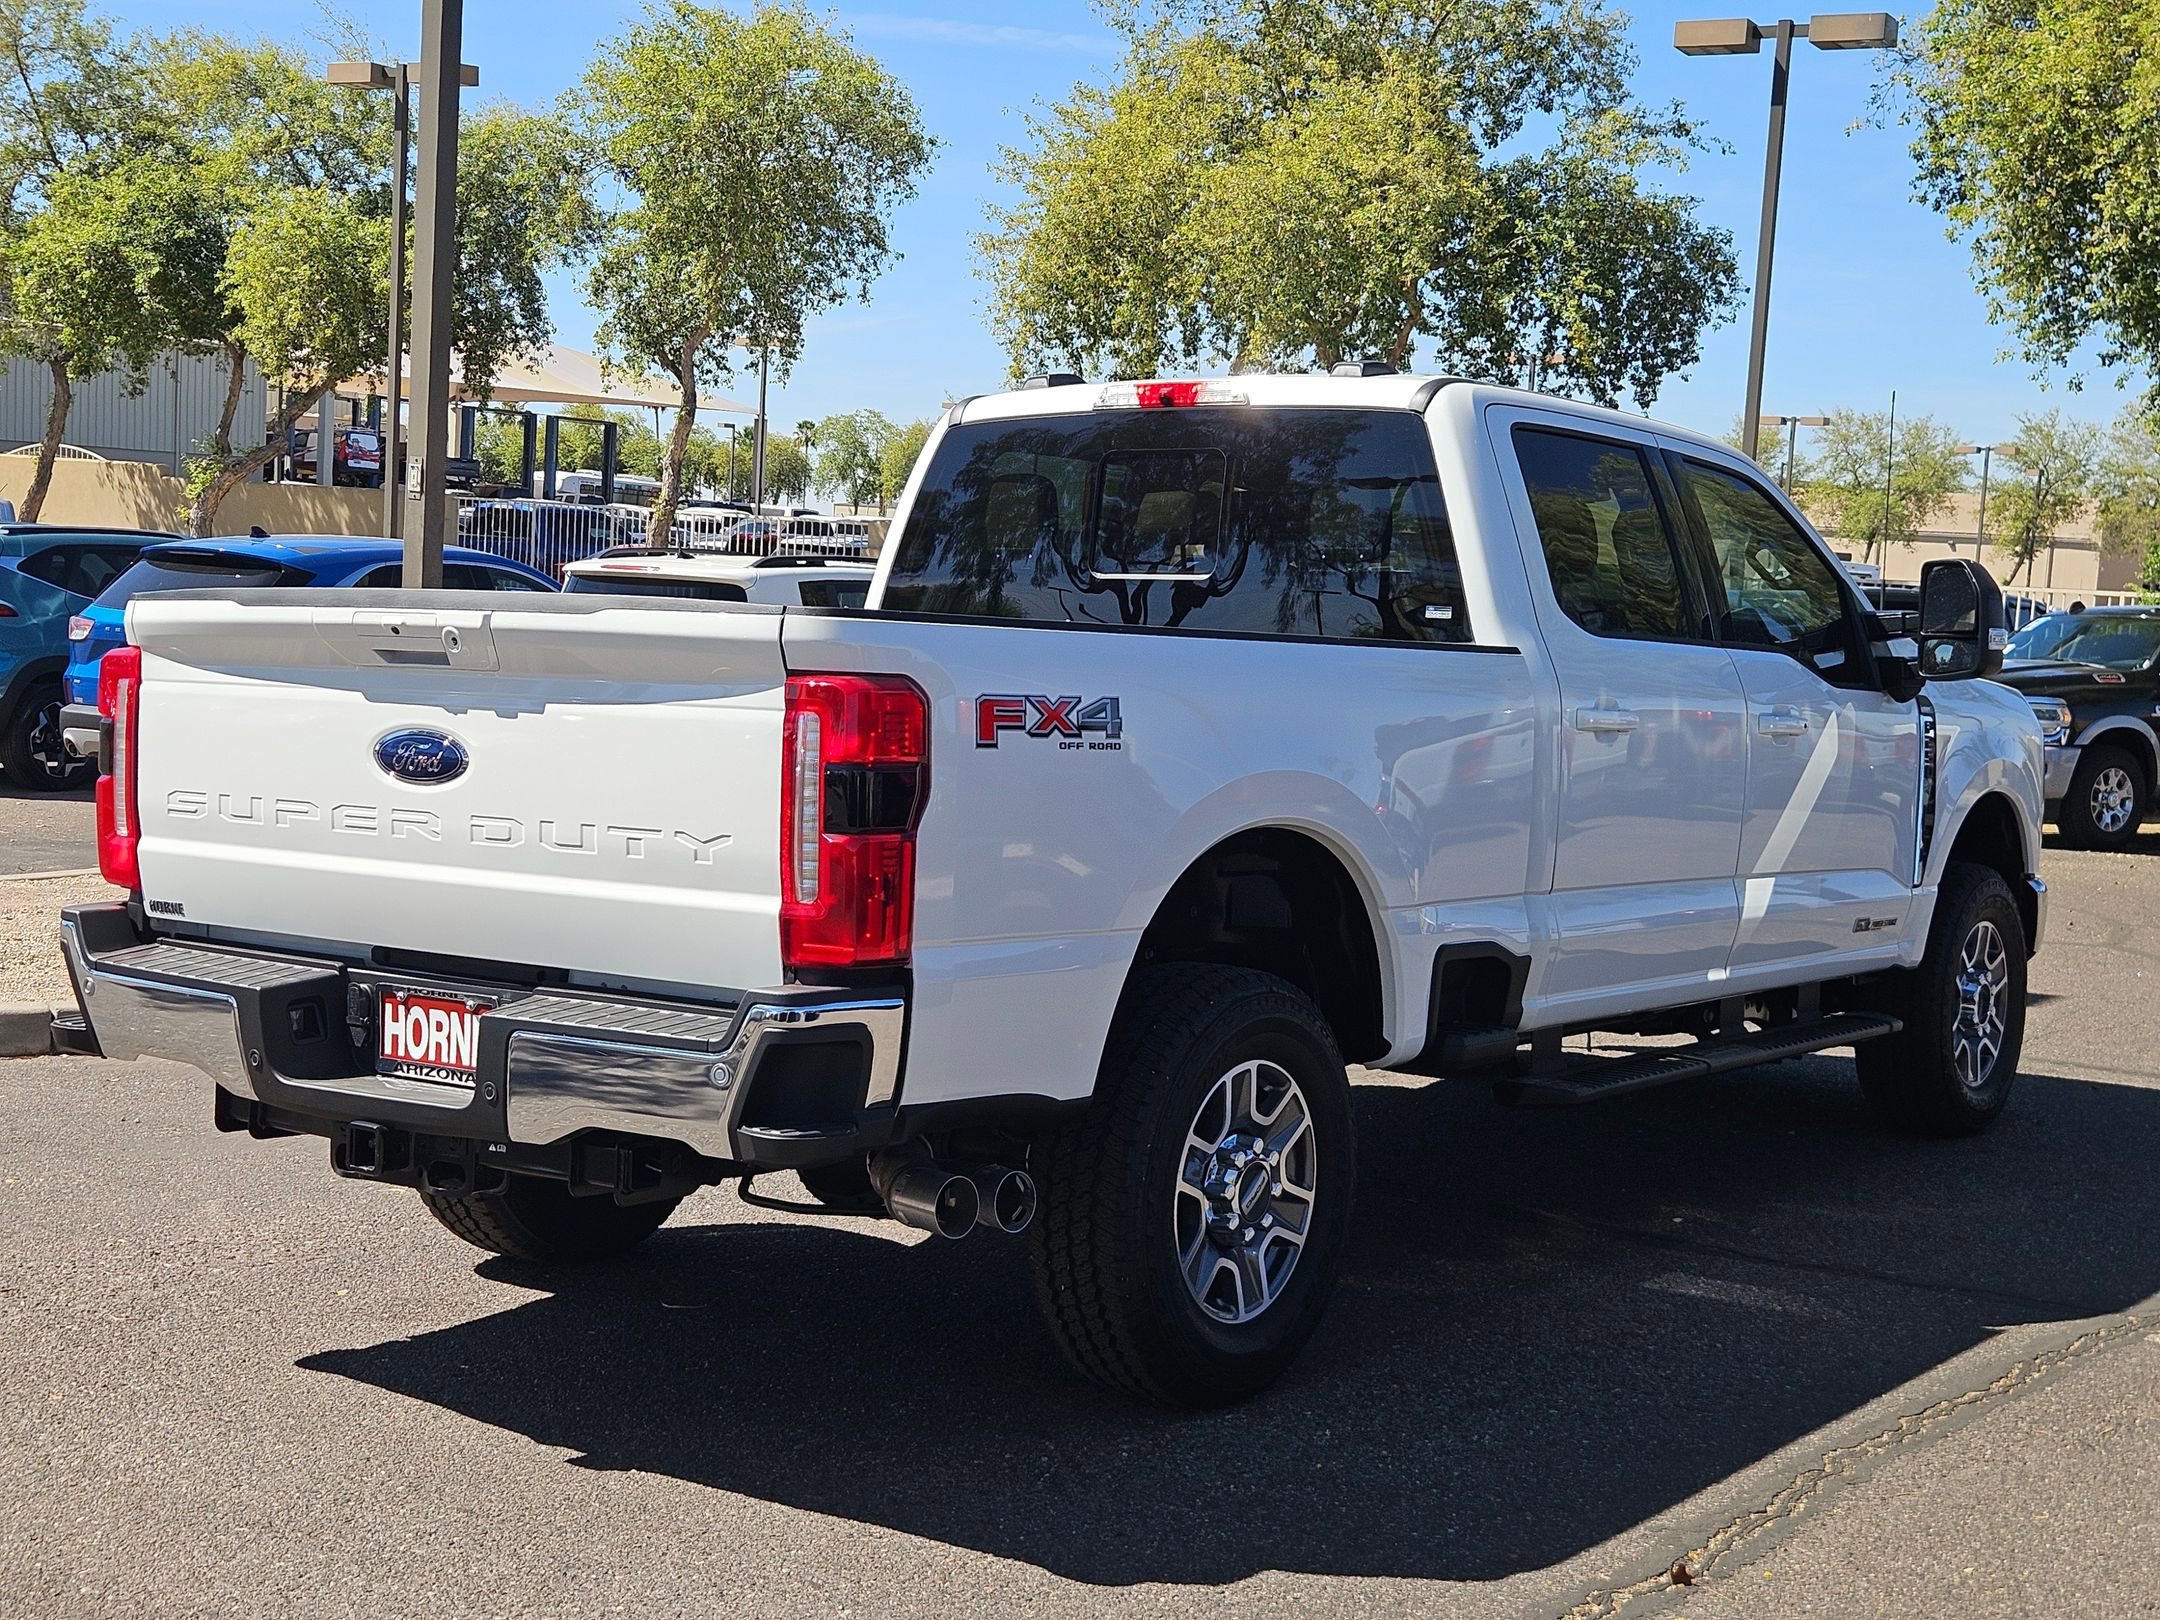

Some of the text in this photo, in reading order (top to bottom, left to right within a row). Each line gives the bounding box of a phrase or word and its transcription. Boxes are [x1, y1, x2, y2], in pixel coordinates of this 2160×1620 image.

[975, 694, 1122, 748] FX4
[392, 741, 444, 772] Ford
[1059, 742, 1121, 750] OFF ROAD
[167, 790, 732, 864] SUPER DUTY
[149, 900, 185, 917] HORNE
[406, 987, 464, 1000] HORNE
[384, 1003, 480, 1067] HORN
[393, 1061, 476, 1084] ARIZONA
